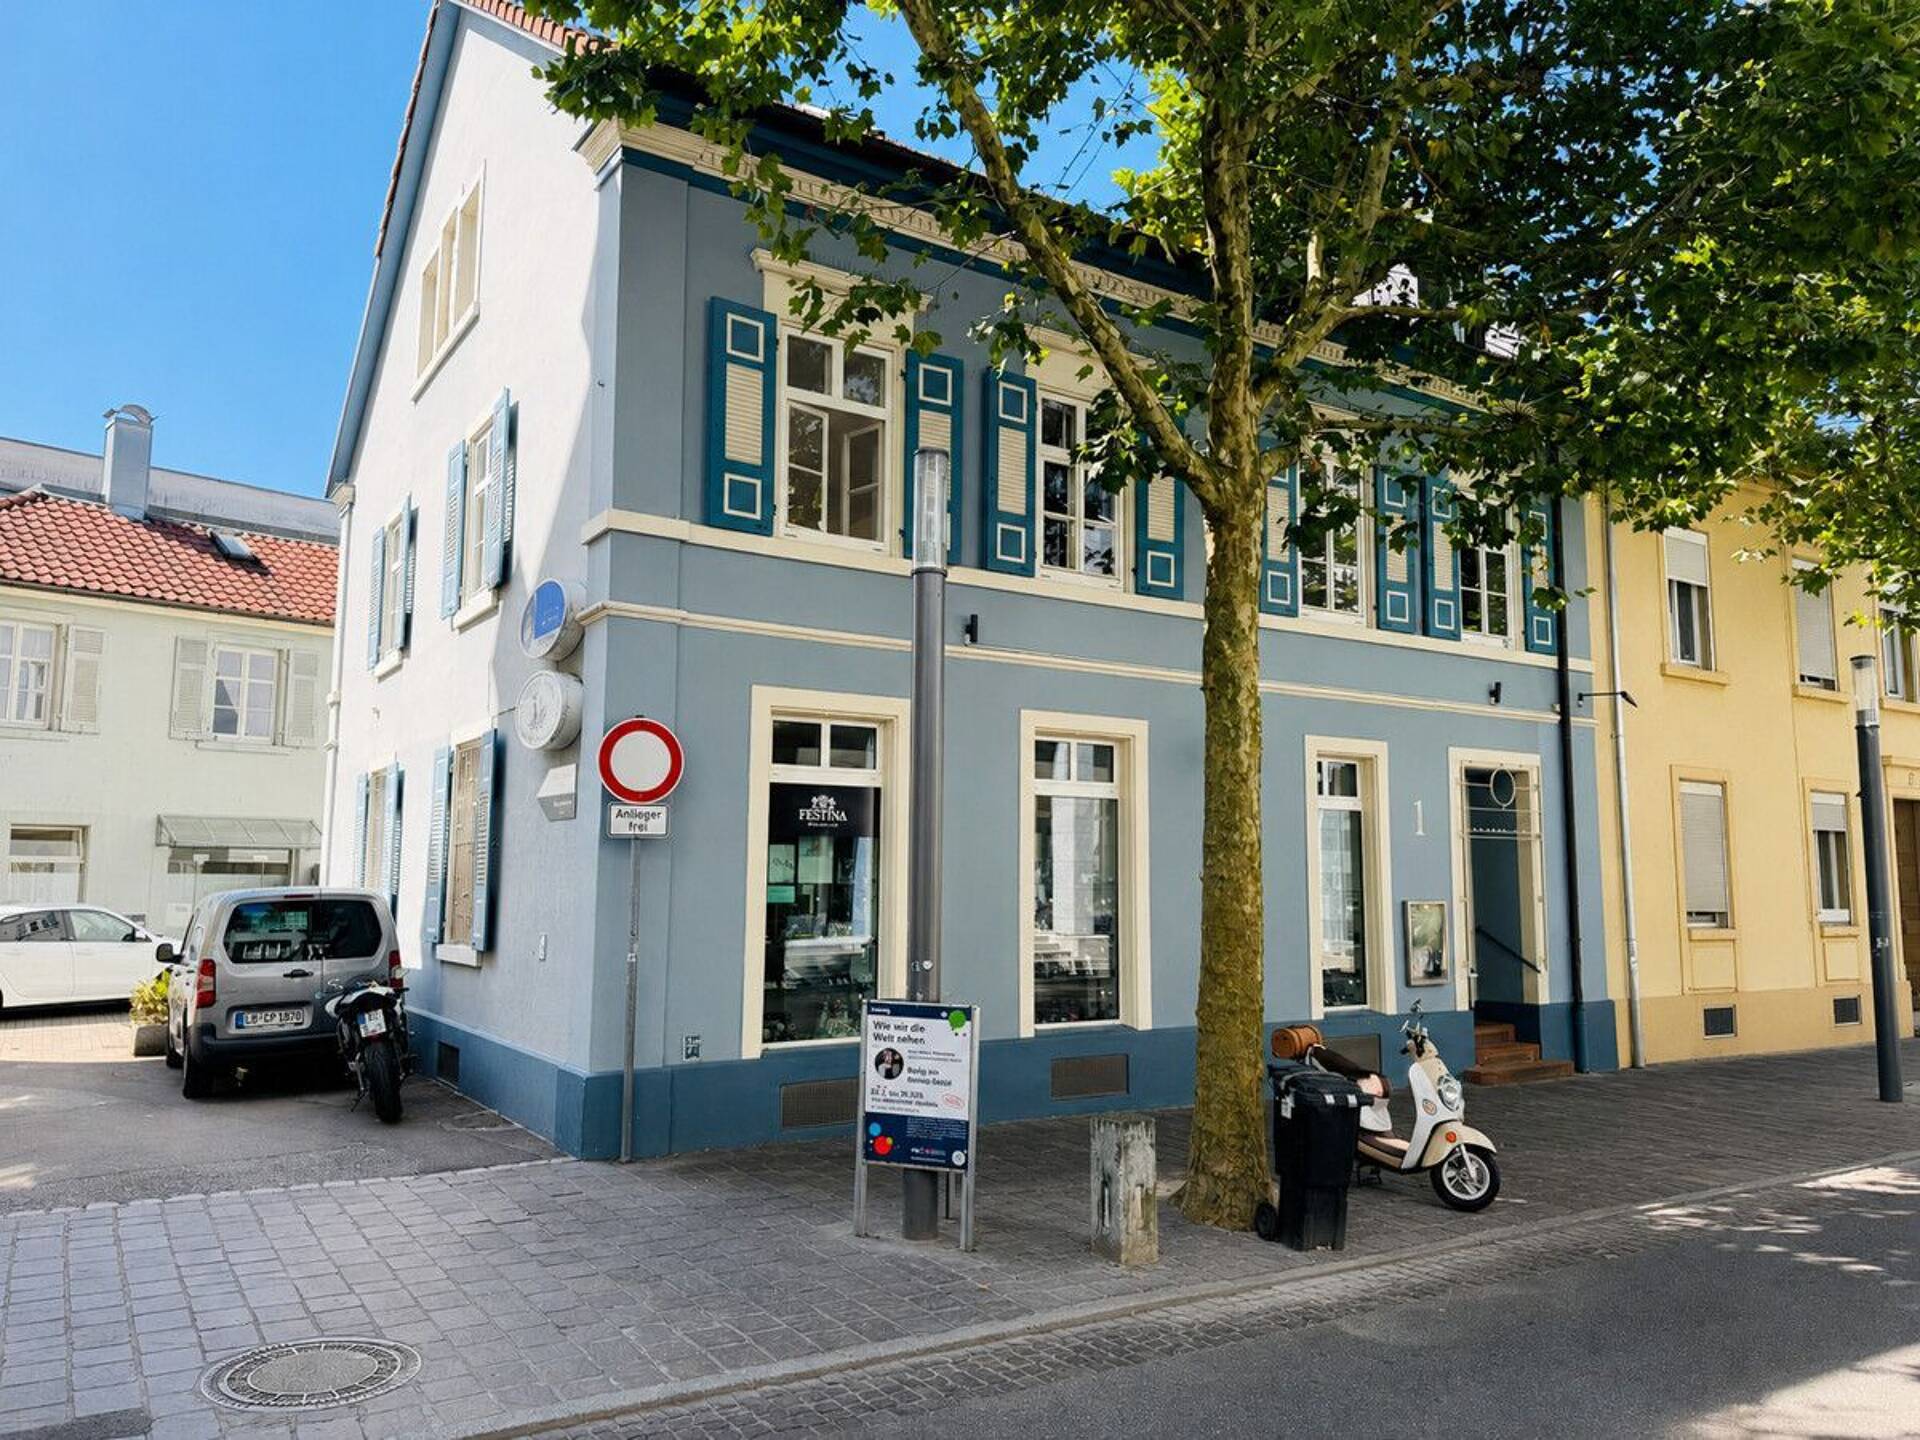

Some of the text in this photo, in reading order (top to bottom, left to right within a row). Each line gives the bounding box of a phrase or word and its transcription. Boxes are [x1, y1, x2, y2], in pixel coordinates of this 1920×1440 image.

[615, 808, 661, 822] Anlieger
[799, 806, 848, 821] FESTINA
[1413, 799, 1426, 836] 1
[628, 821, 648, 832] frei
[873, 1020, 926, 1033] Wie wir die
[873, 1032, 895, 1043] Welt
